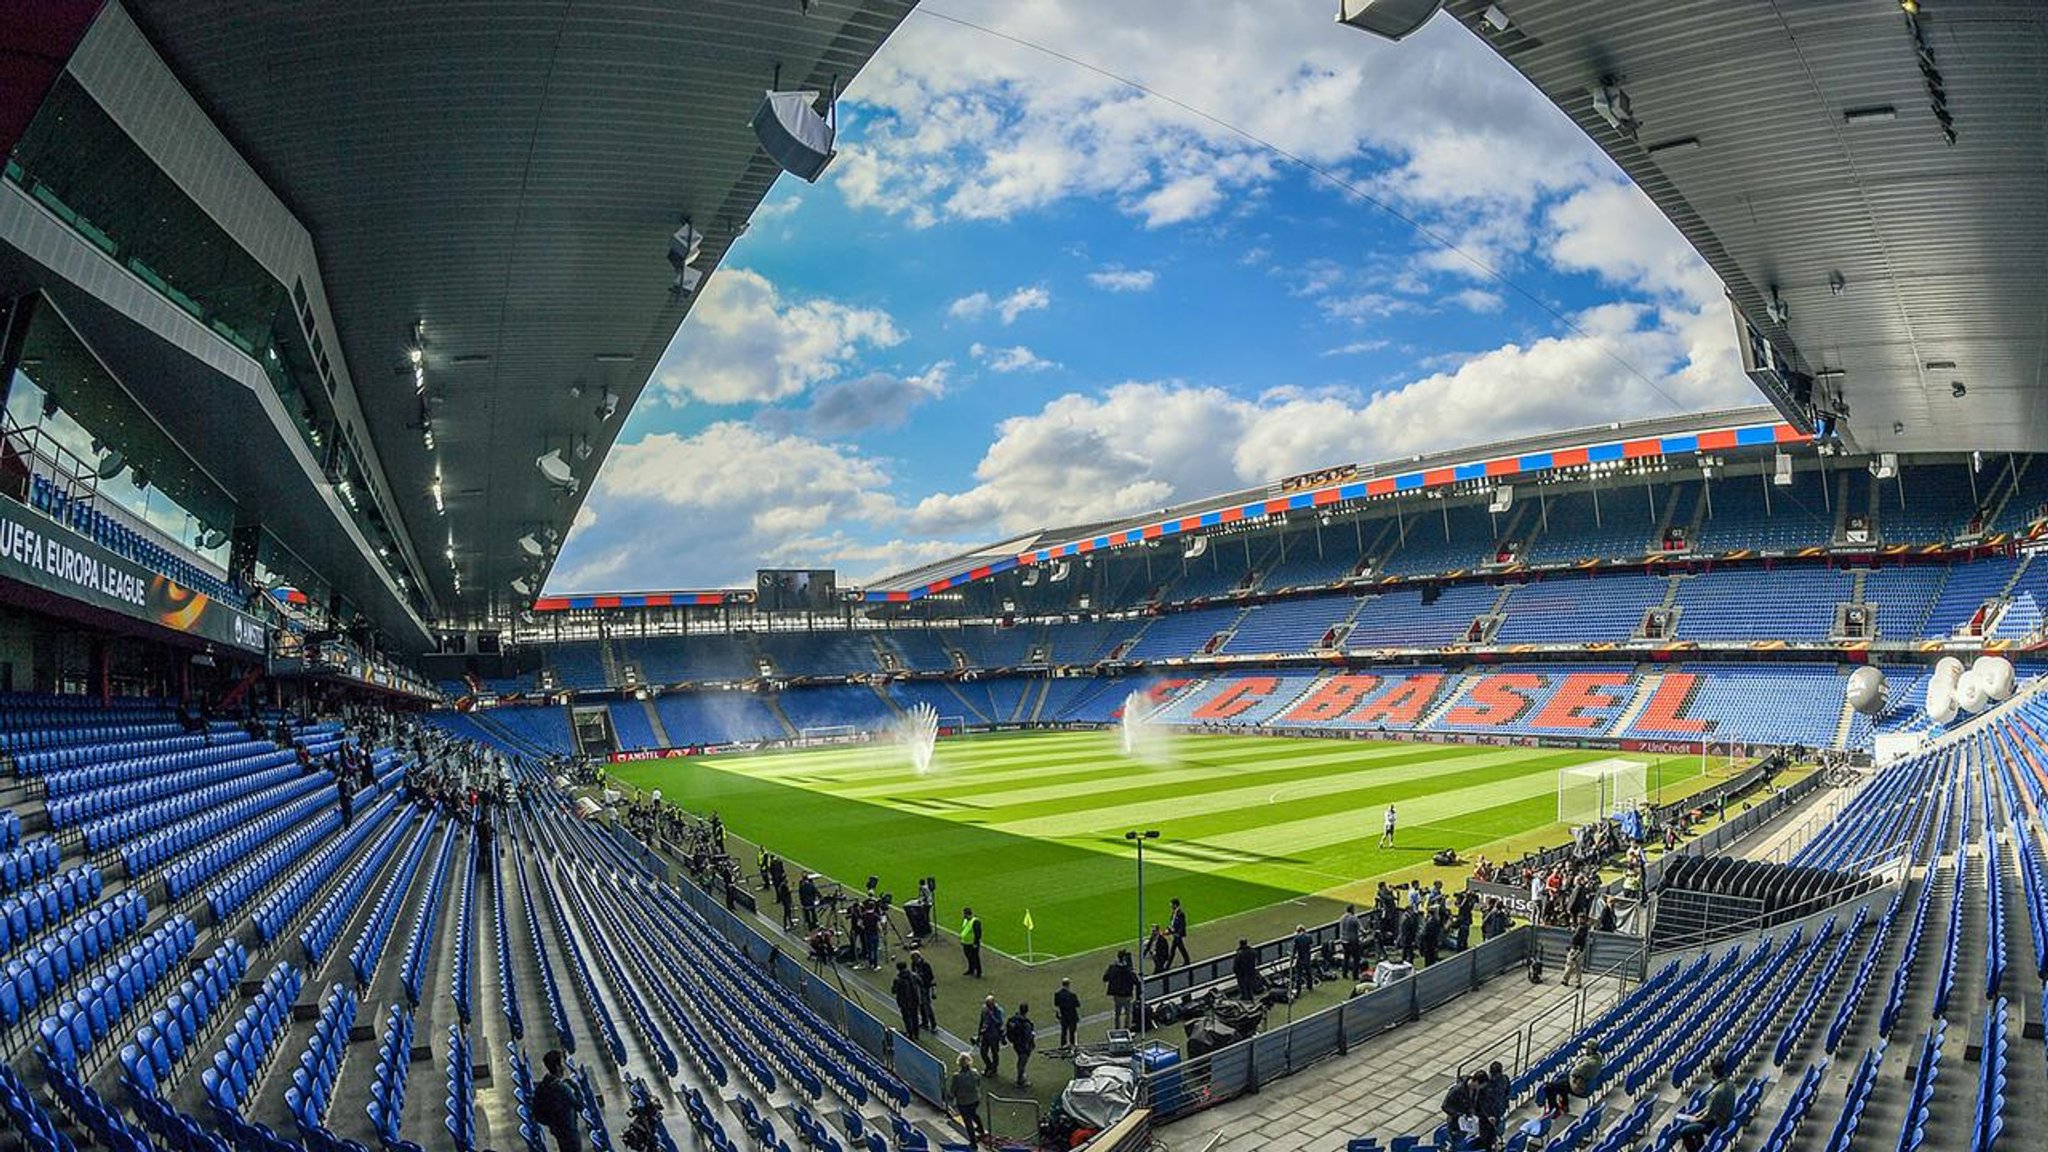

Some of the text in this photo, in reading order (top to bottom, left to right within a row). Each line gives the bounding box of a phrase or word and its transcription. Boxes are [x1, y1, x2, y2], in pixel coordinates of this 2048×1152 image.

[0, 518, 146, 606] UEFA EUROPA LEAGUE
[1283, 673, 1718, 732] BASEL
[628, 752, 660, 761] AMSTEL
[1648, 742, 1691, 754] UniCredit
